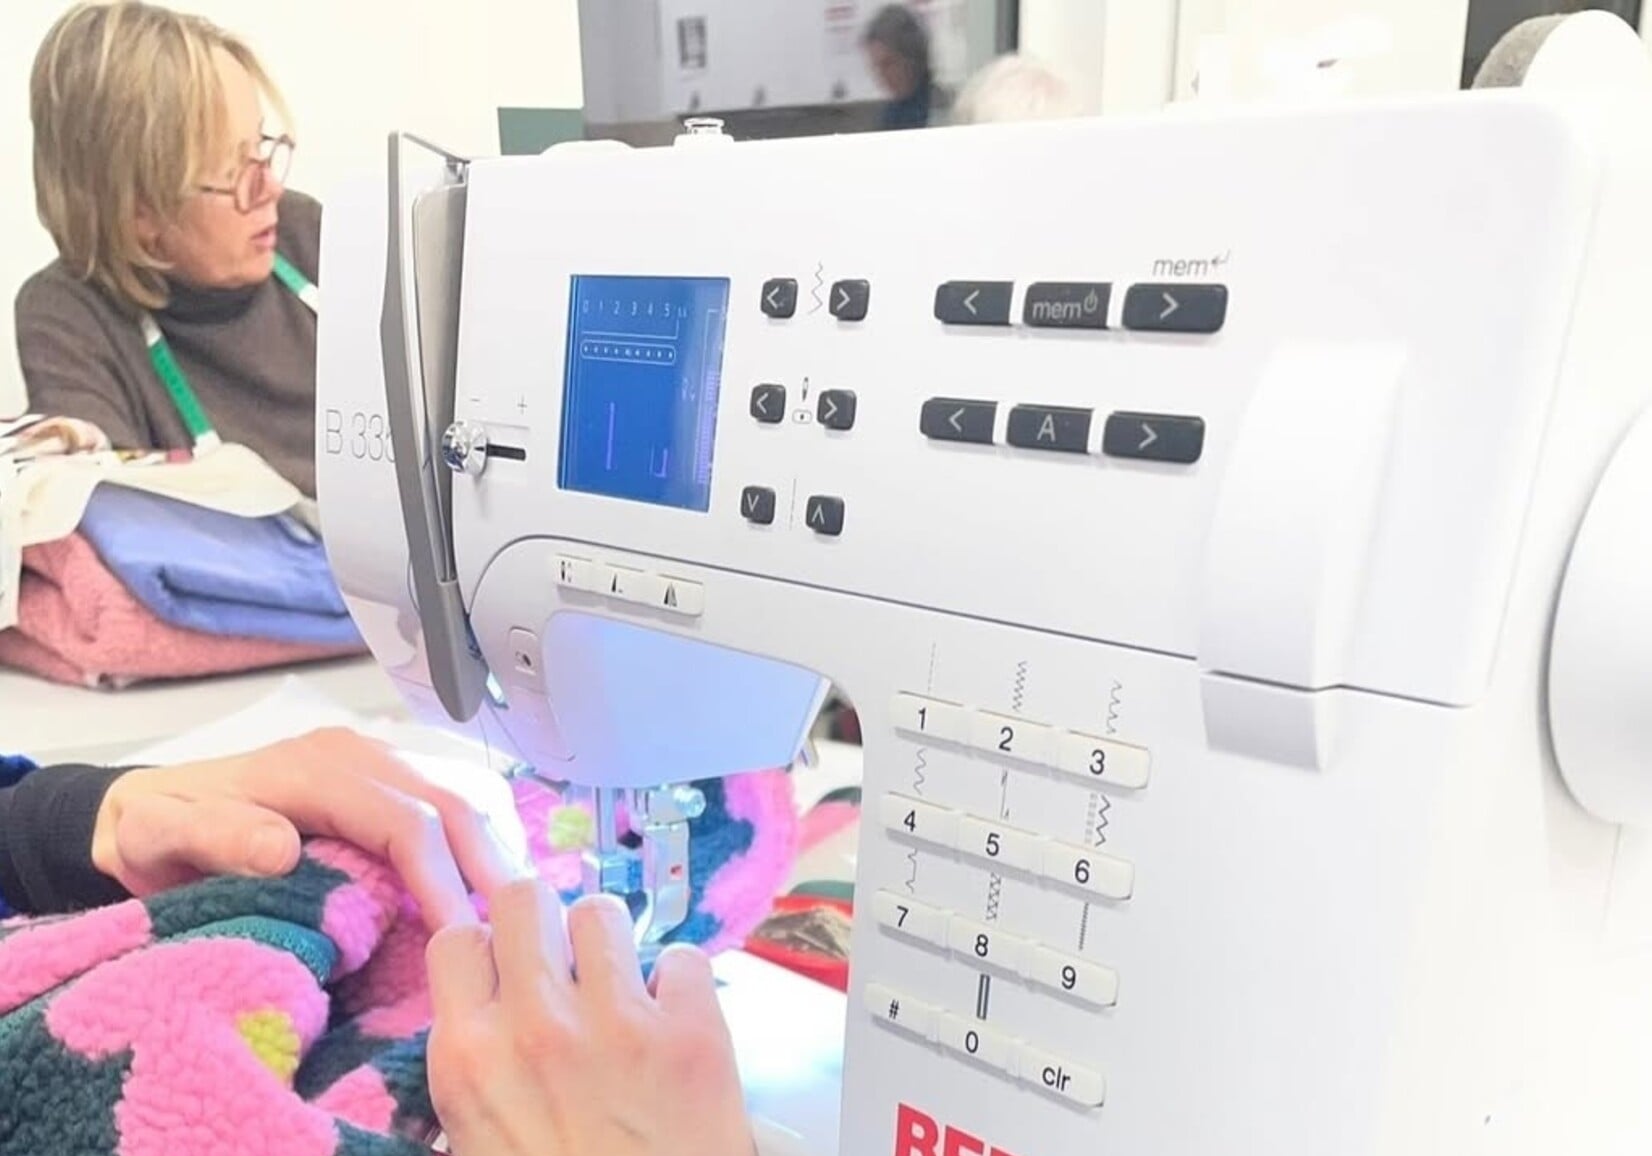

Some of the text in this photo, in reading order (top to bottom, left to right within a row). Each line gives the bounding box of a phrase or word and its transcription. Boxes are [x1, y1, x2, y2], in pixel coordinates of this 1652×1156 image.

[1153, 258, 1208, 277] mem
[613, 301, 621, 315] 2
[631, 302, 638, 316] 3
[664, 303, 671, 317] 5
[1032, 300, 1083, 321] mem
[325, 408, 343, 455] B
[1036, 414, 1057, 442] A
[917, 707, 1106, 775] 1 2 3
[903, 810, 1090, 884] 4 5 6
[897, 905, 1077, 990] 7 8 9
[889, 999, 1071, 1092] # 0 clr
